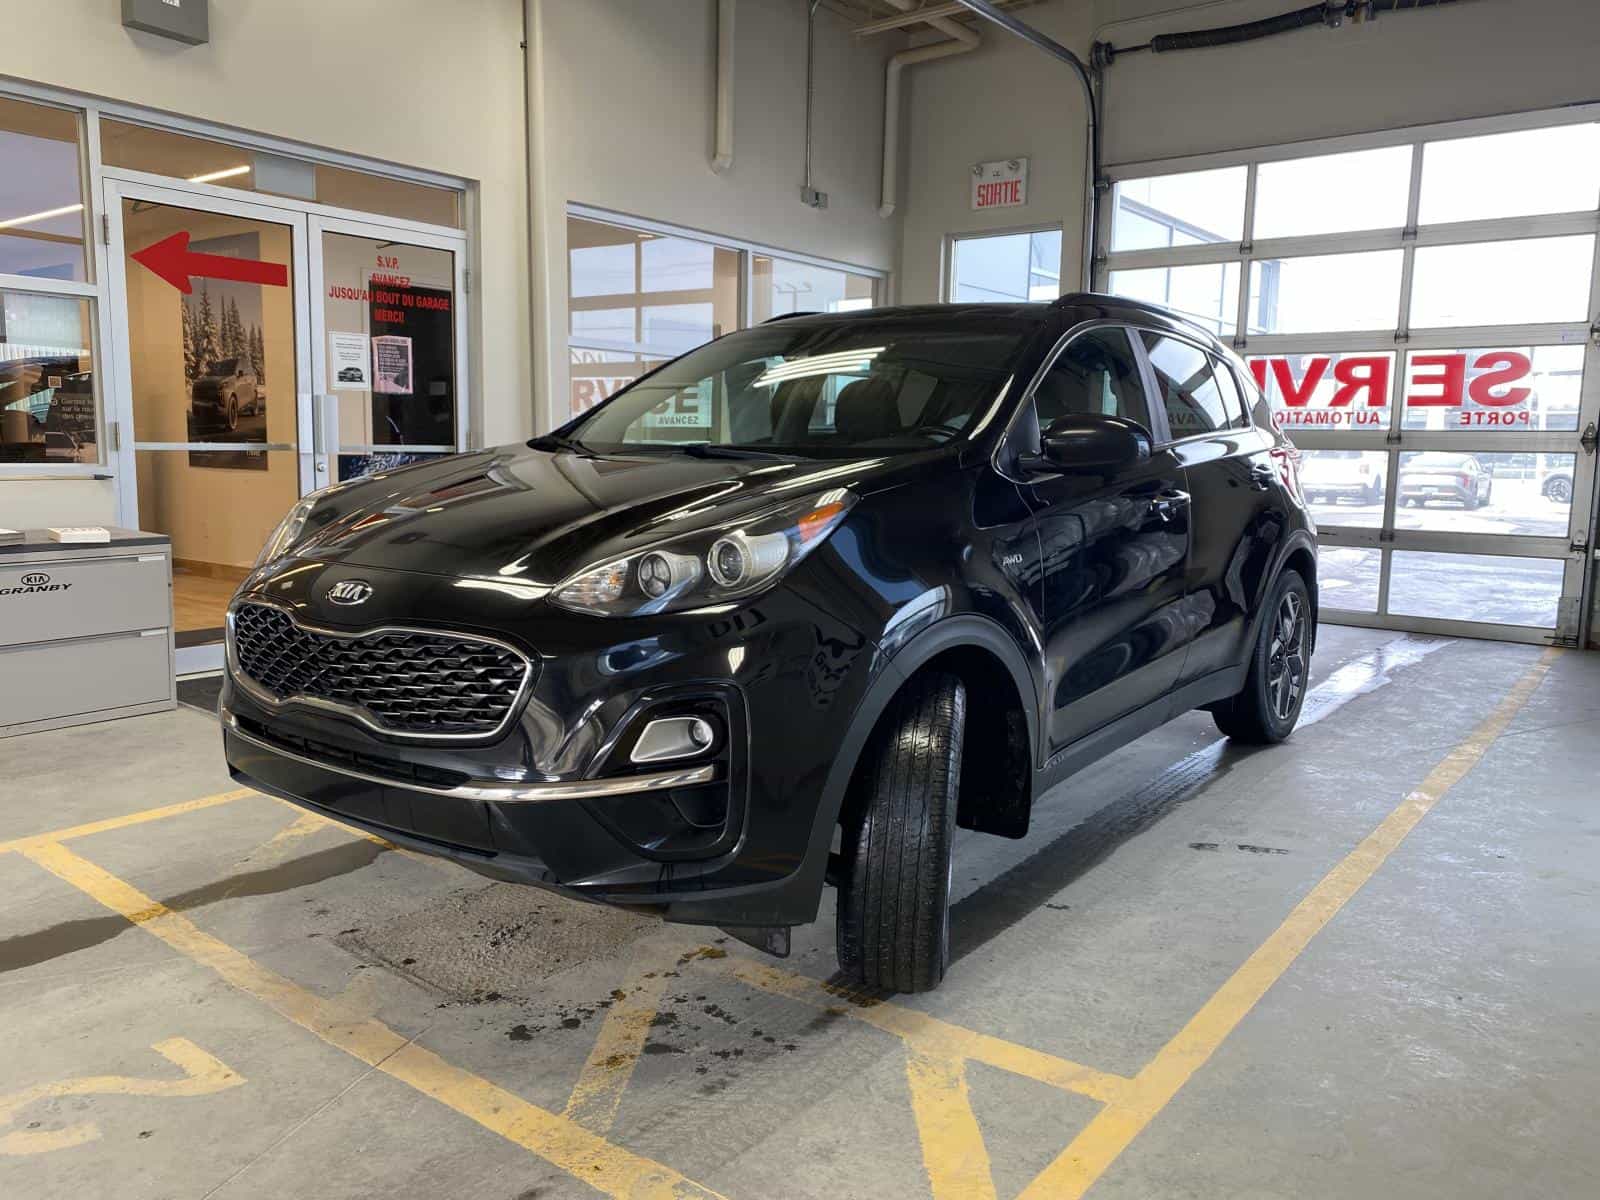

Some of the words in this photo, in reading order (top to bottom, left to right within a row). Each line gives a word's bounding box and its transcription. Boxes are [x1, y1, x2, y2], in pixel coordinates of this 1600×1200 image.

[977, 180, 1021, 206] SORTIE
[376, 255, 400, 269] S.V.P.
[371, 272, 411, 288] AVANCEZ
[329, 285, 374, 302] JUSQU'AU
[376, 289, 400, 305] BOUT
[402, 293, 415, 307] DU
[416, 295, 449, 311] GARAGE
[658, 415, 699, 425] AVANCEZ
[24, 575, 47, 585] KIA
[0, 583, 72, 596] GRANBY
[331, 582, 365, 600] KIA
